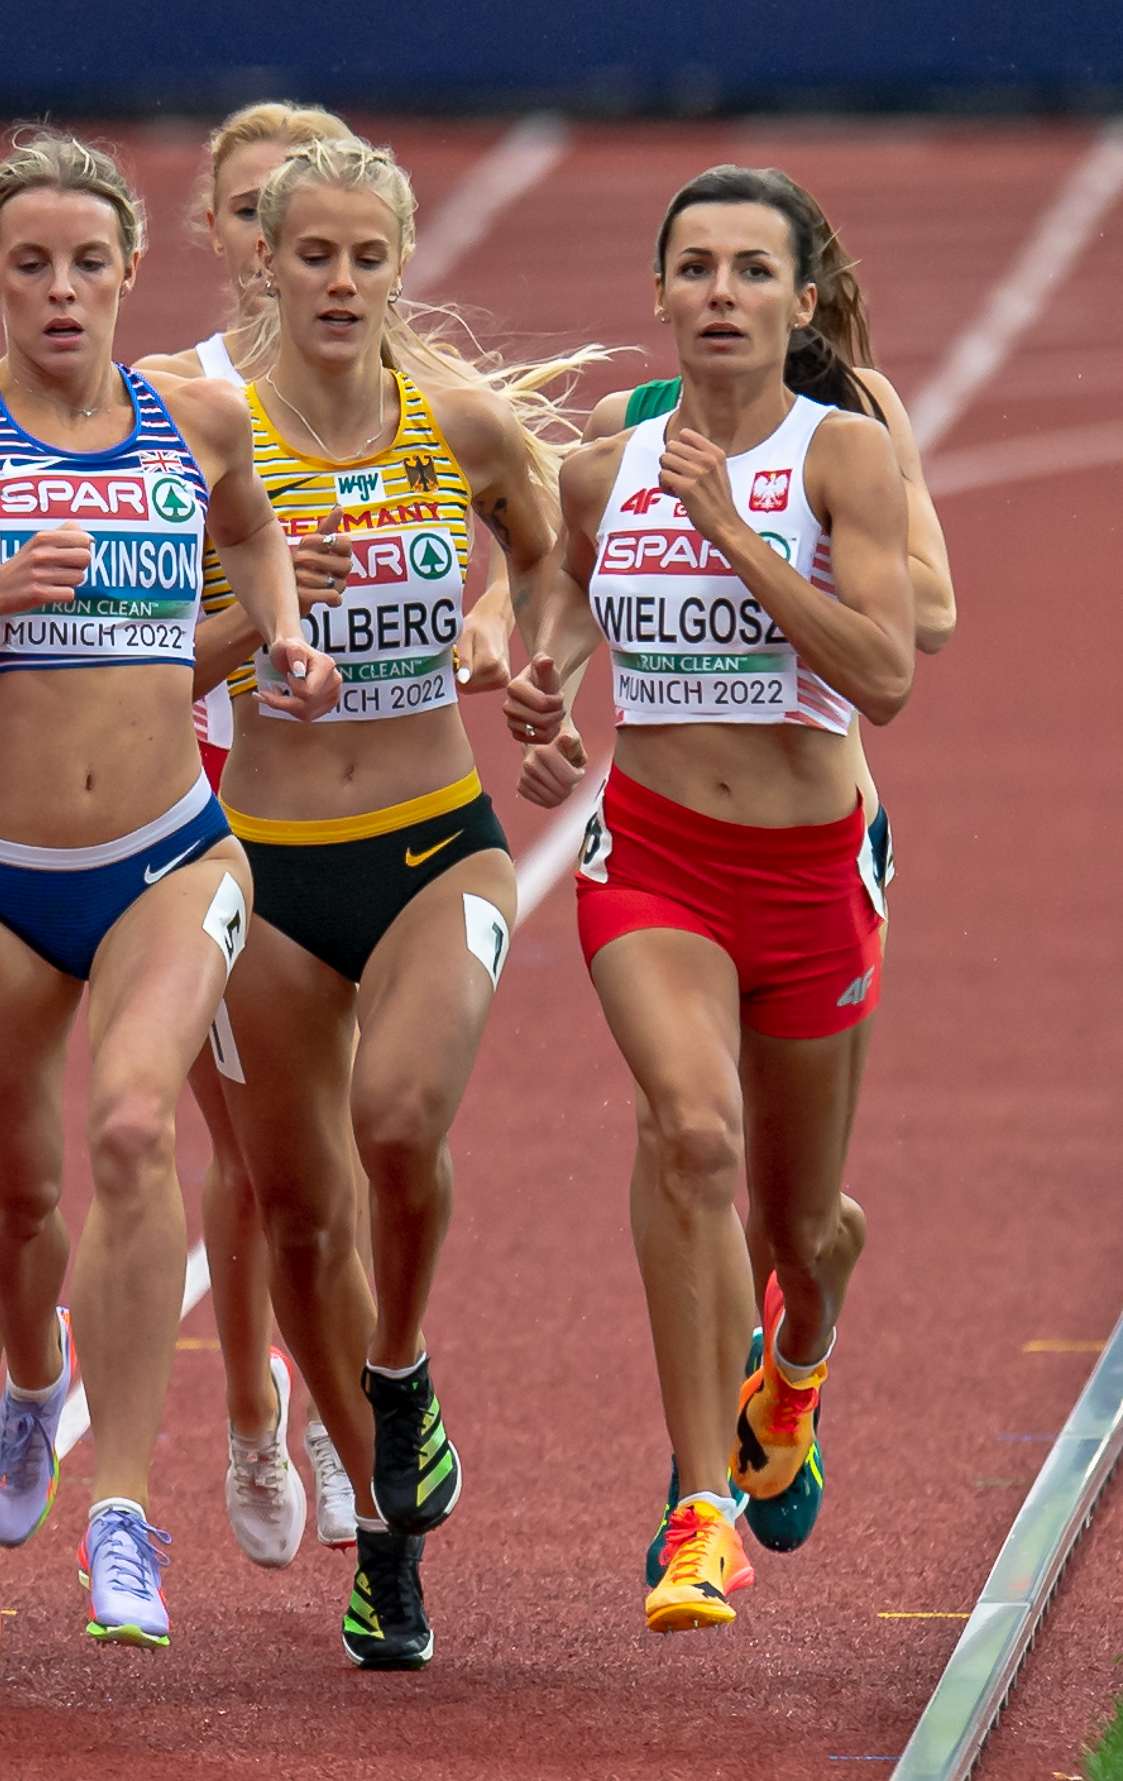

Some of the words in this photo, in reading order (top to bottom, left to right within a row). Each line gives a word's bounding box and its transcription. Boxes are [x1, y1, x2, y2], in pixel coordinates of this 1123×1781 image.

[0, 480, 145, 514] SPAR
[3, 620, 117, 647] MUNICH
[124, 623, 182, 650] 2022
[300, 598, 458, 655] OLBERG
[390, 674, 446, 710] 2022
[619, 674, 703, 705] MUNICH
[712, 679, 784, 705] 2022
